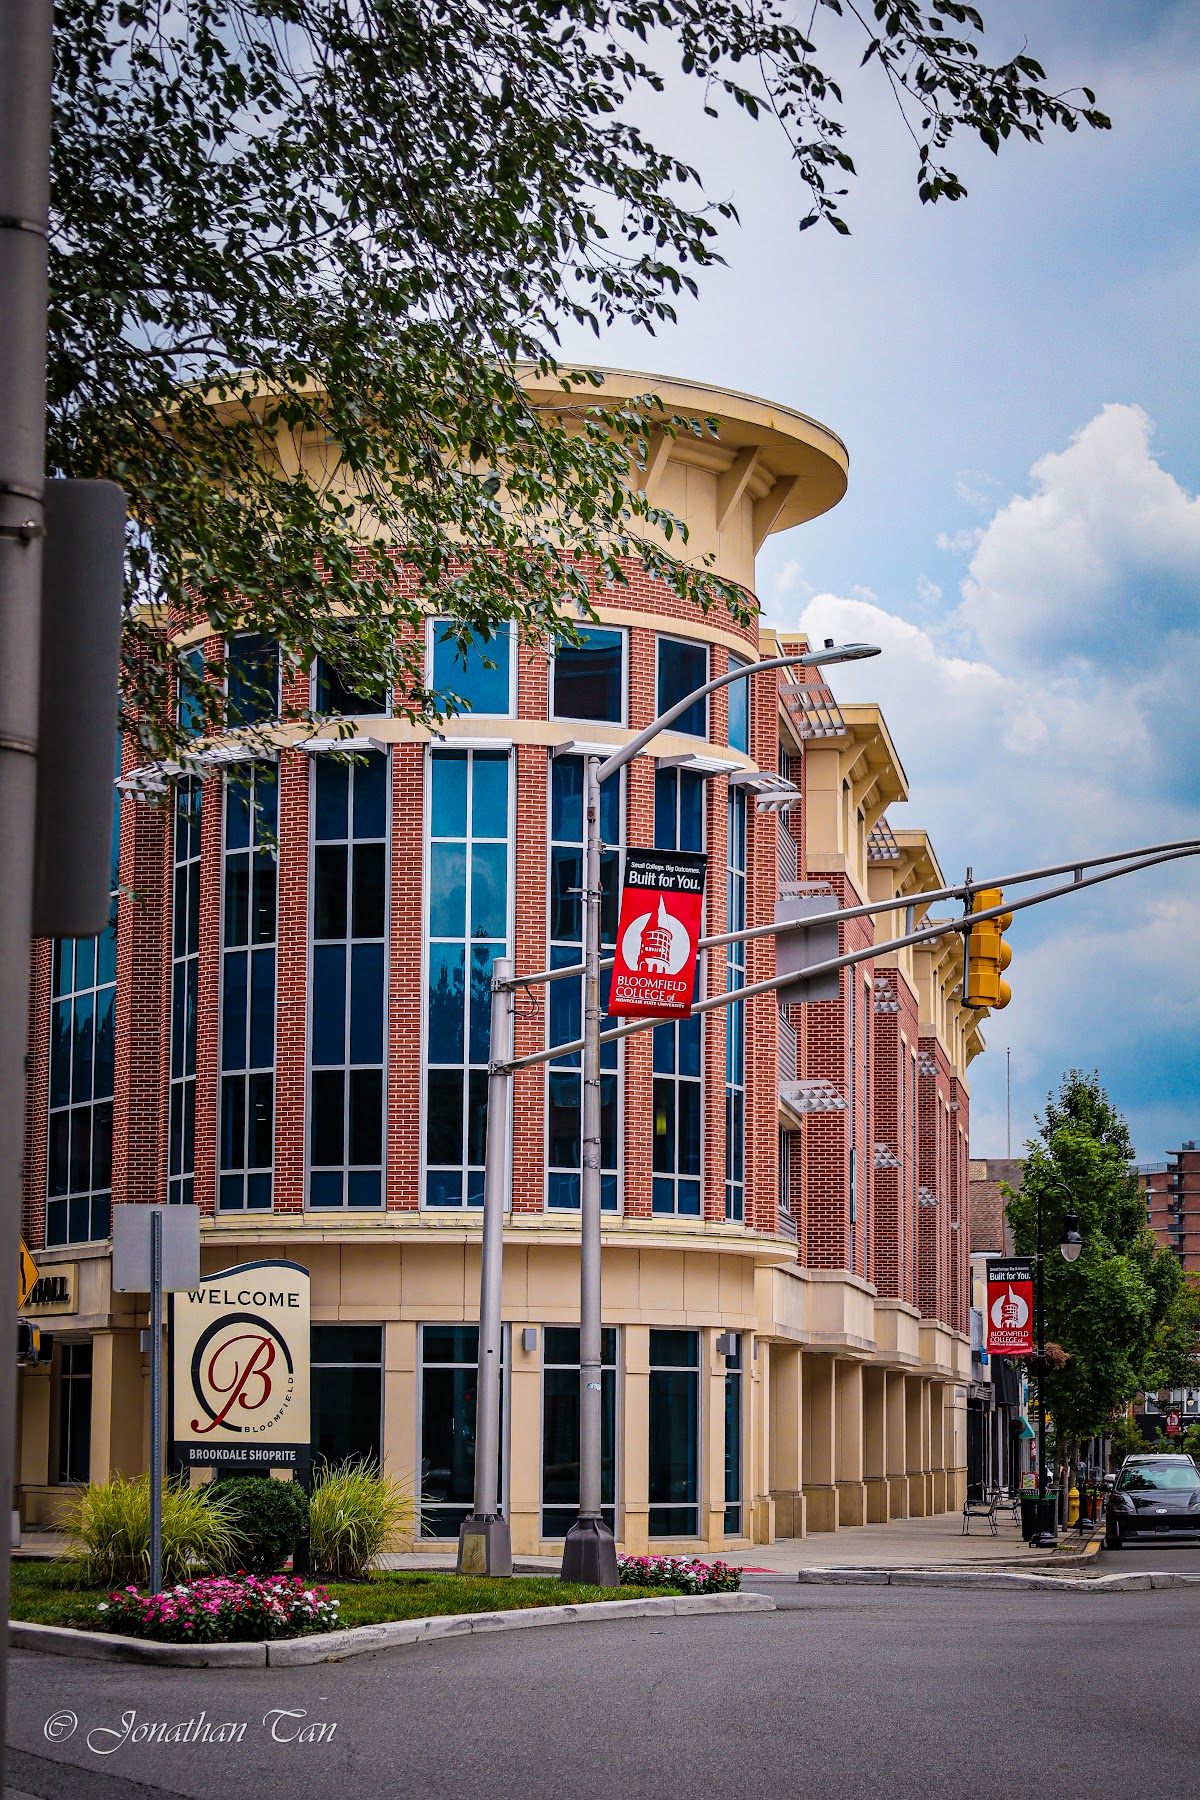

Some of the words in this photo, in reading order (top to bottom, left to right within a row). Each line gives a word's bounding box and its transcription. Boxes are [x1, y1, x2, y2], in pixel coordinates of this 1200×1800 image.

[631, 861, 645, 869] Small
[646, 863, 664, 871] College.
[675, 866, 700, 874] Outcomes.
[629, 871, 656, 885] Built
[659, 873, 675, 887] for
[677, 875, 700, 890] You.
[617, 976, 687, 991] BLOOMFIELD
[616, 987, 665, 1000] COLLEGE
[667, 993, 675, 1001] of
[990, 1272, 1005, 1280] Built
[1007, 1272, 1016, 1280] for
[188, 1290, 300, 1308] WELCOME
[244, 1377, 294, 1433] BLOOMFIELD
[189, 1449, 247, 1460] BROOKDALE
[249, 1450, 296, 1461] SHOPRITE
